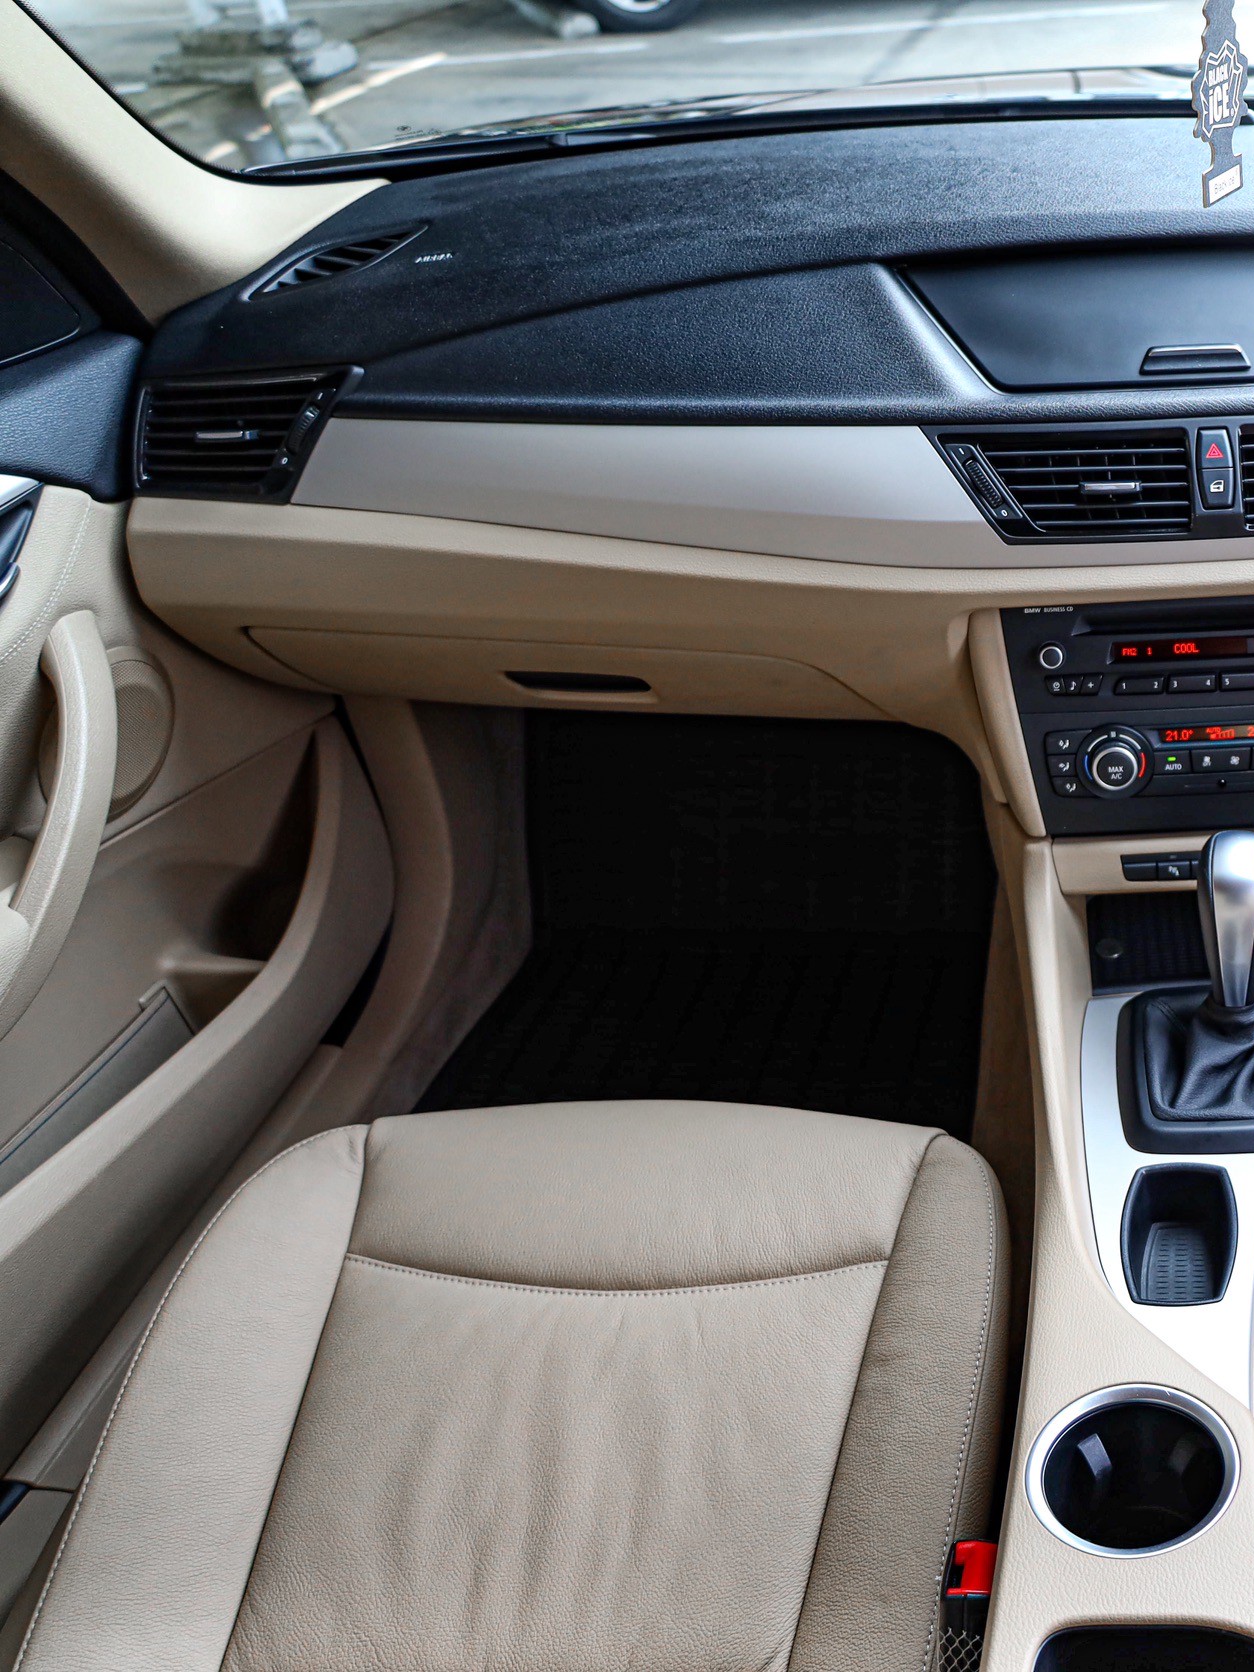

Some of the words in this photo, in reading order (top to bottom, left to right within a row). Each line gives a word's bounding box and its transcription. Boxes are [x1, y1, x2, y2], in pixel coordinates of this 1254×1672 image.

[1208, 64, 1228, 87] BLACK
[1173, 642, 1199, 654] COOL
[1121, 682, 1127, 690] 1
[1153, 681, 1159, 689] 2
[1172, 680, 1178, 688] 3
[1205, 679, 1211, 687] 4
[1224, 678, 1230, 686] 5
